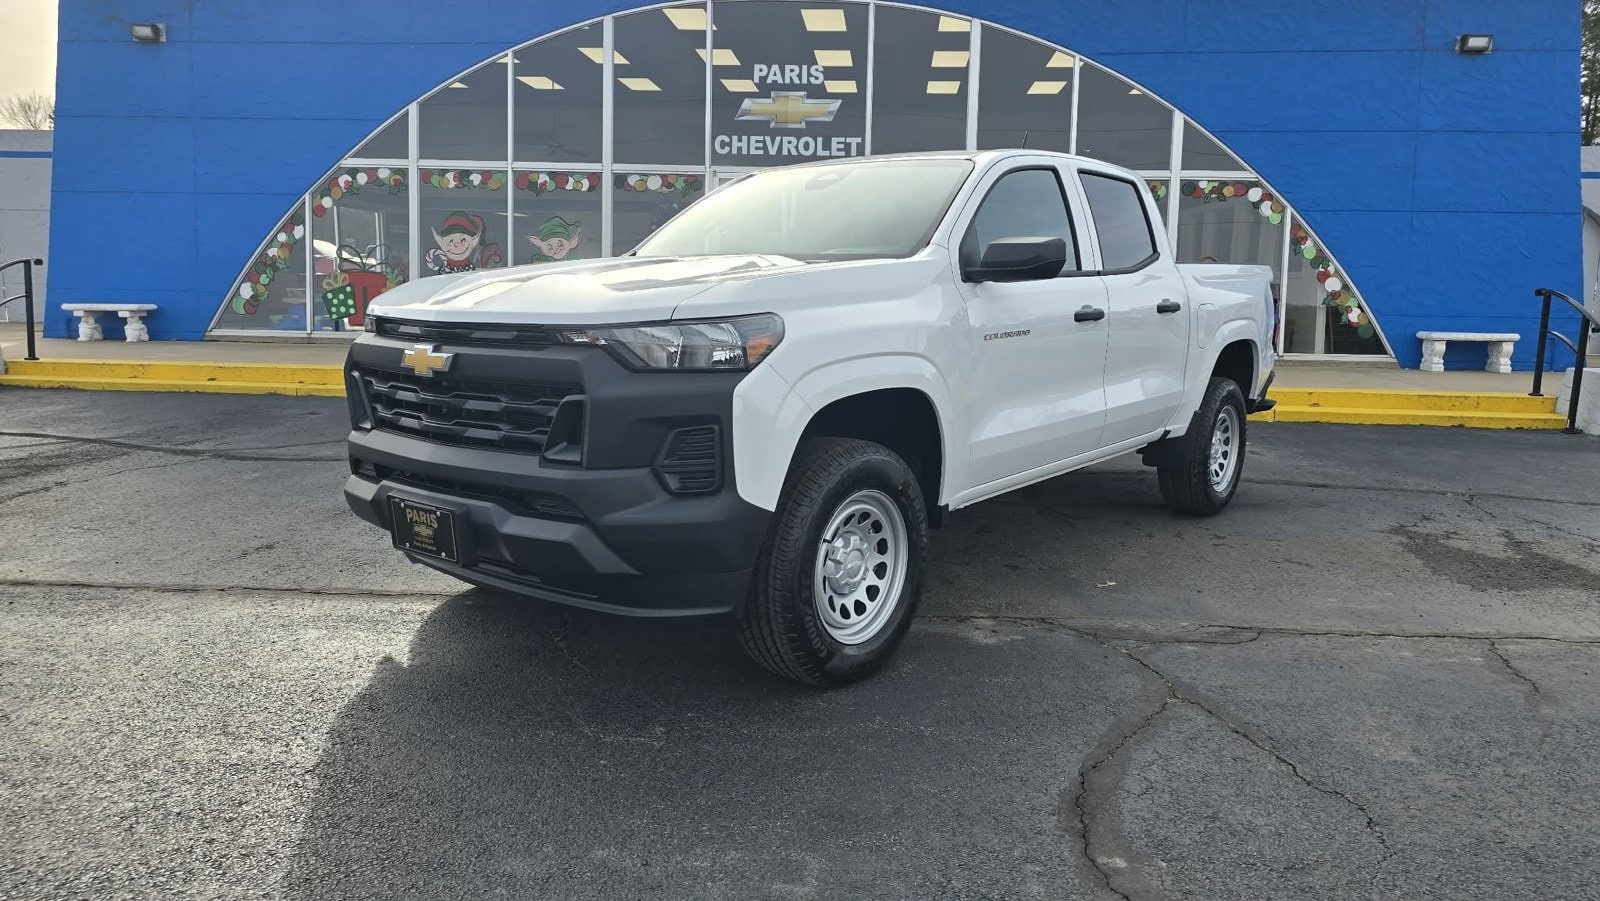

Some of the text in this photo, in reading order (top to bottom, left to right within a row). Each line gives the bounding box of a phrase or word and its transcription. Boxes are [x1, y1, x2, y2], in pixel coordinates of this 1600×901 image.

[753, 63, 825, 85] PARIS
[714, 134, 862, 157] CHEVROLET
[983, 329, 1031, 341] COLORADO
[405, 508, 438, 529] PARIS
